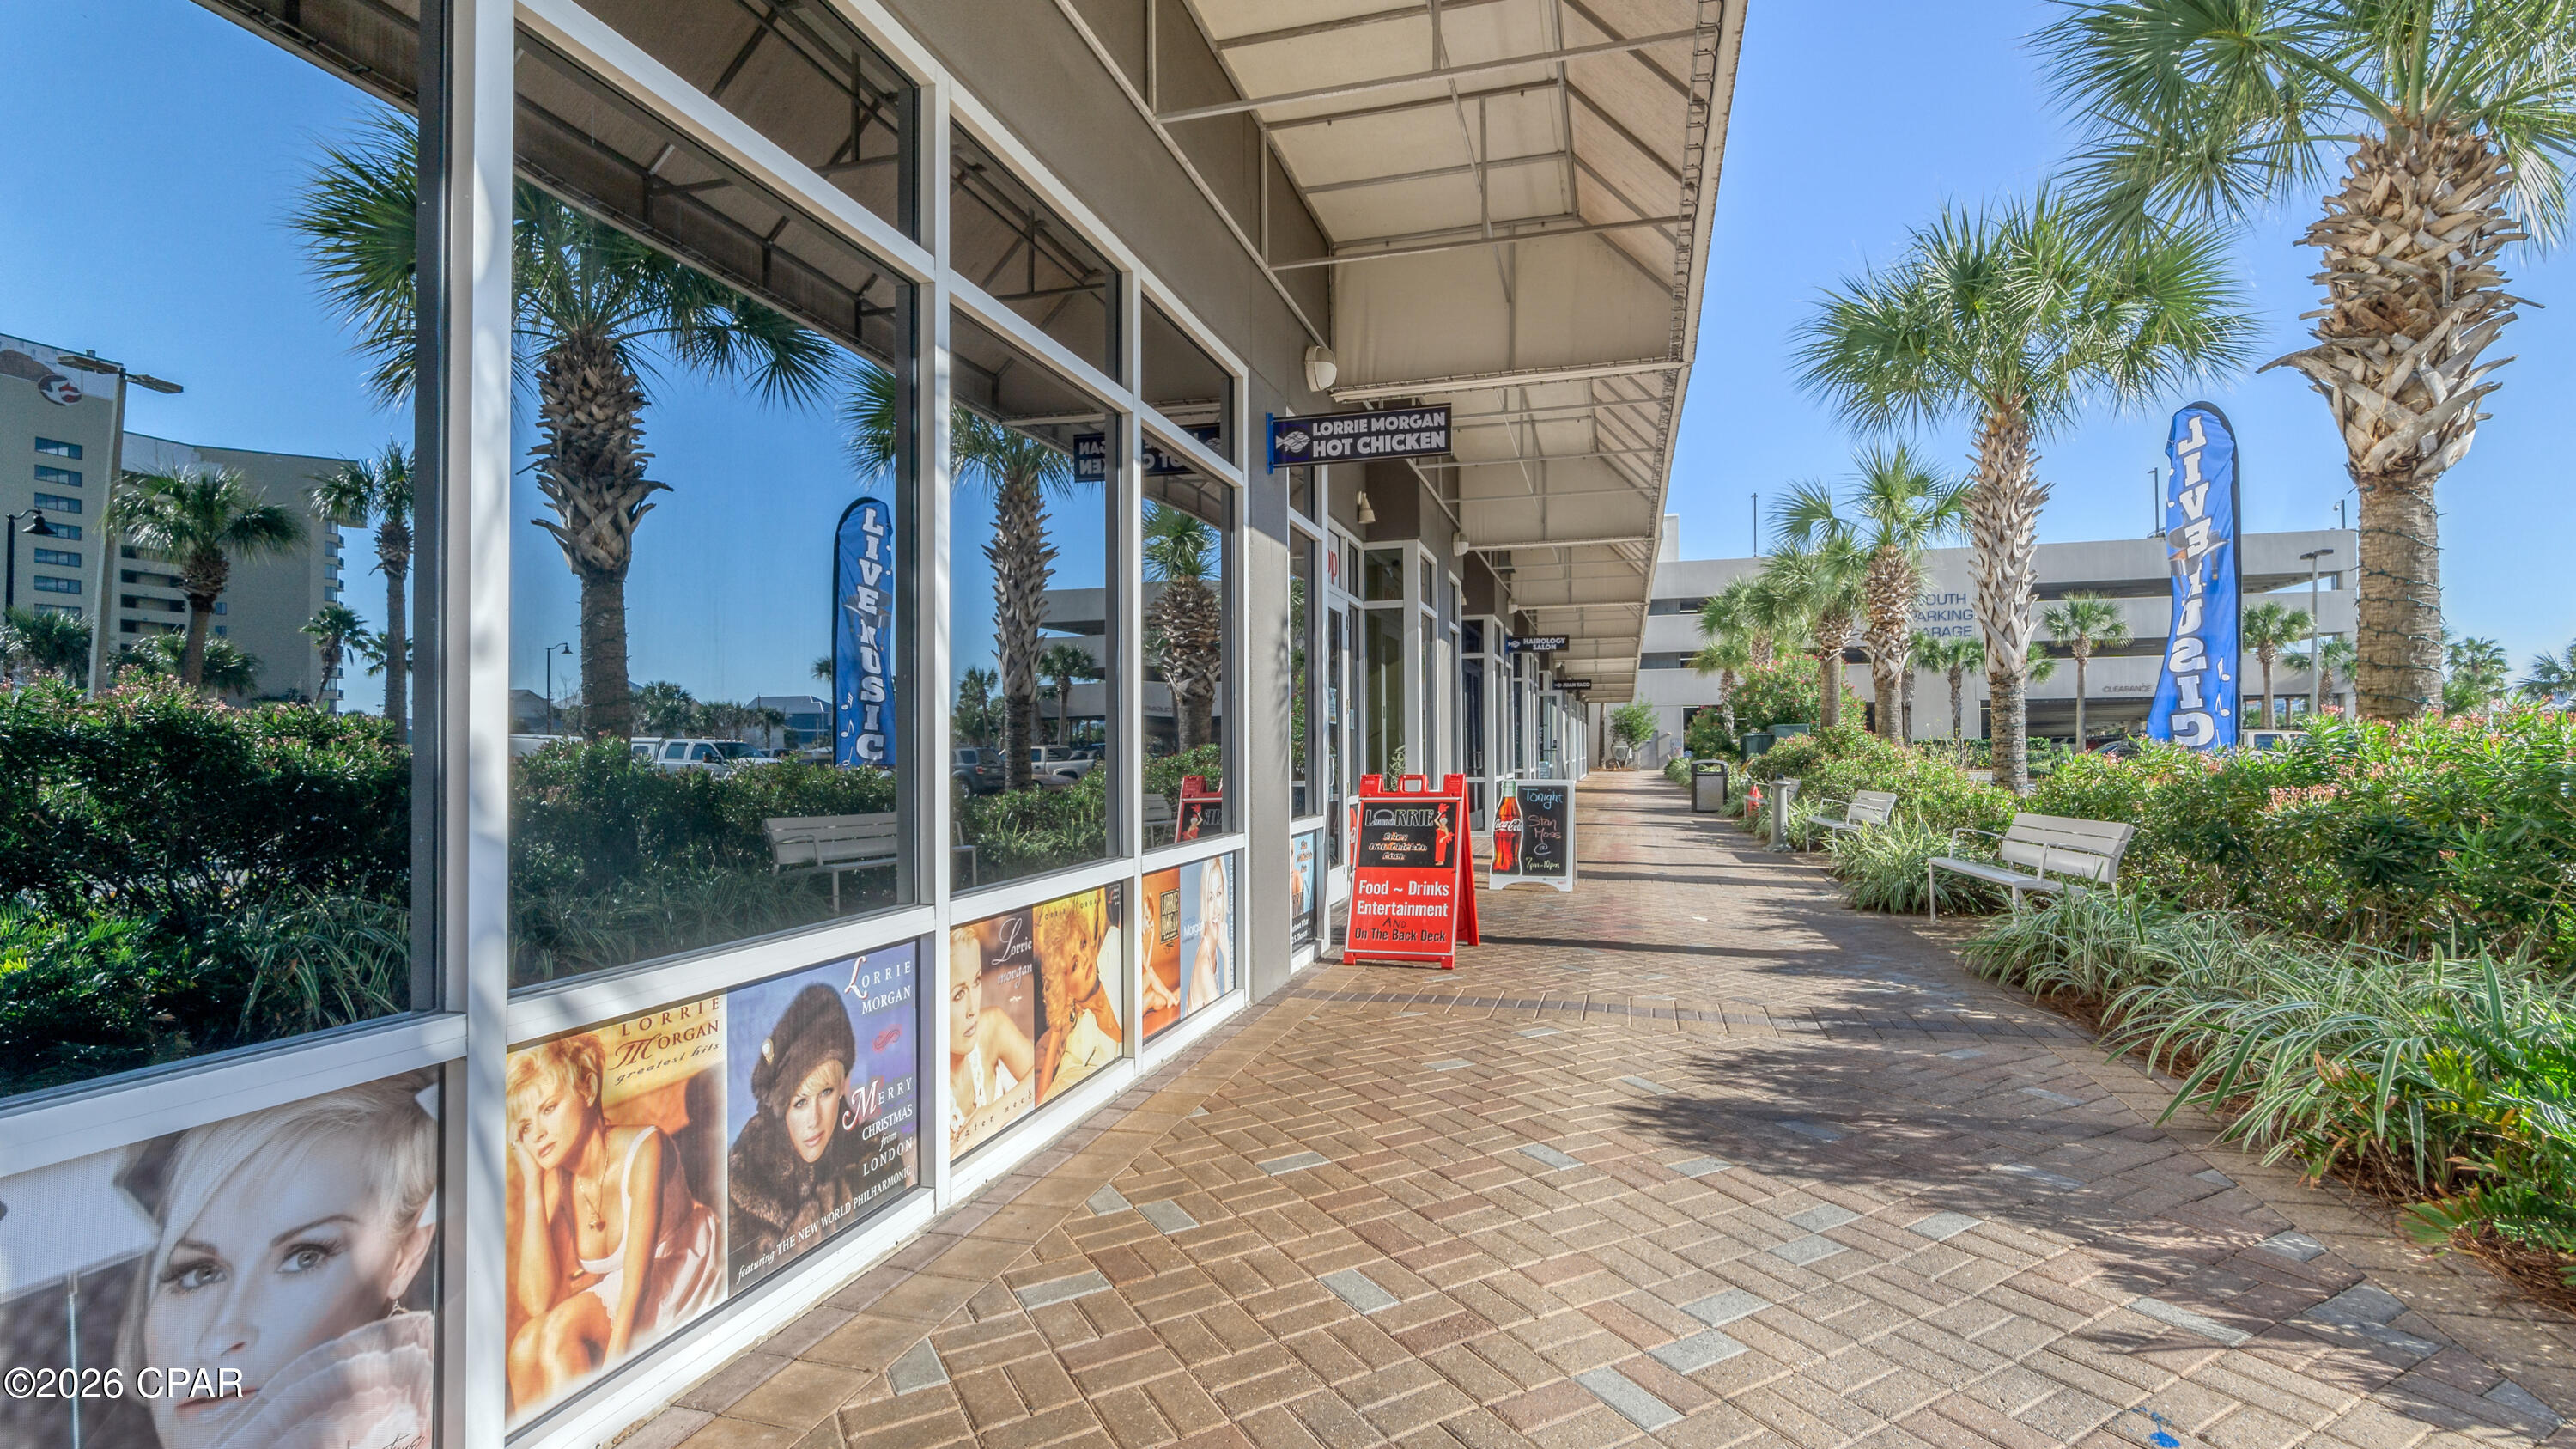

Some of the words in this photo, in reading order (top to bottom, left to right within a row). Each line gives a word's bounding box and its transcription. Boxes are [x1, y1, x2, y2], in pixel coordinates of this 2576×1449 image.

[1313, 418, 1367, 436] LORRIE
[1371, 412, 1445, 432] MORGAN
[1313, 438, 1353, 458] HOT
[1357, 430, 1446, 454] CHICKEN
[857, 508, 884, 615] LIVE
[1523, 636, 1565, 645] HAIROLOGY
[1911, 625, 1972, 637] ARAGE
[2102, 685, 2151, 693] CLEARANCE
[1521, 788, 1564, 810] Tonight
[1365, 809, 1434, 826] LORRIE
[1528, 815, 1557, 831] Stan
[1534, 828, 1561, 843] Moss
[1358, 880, 1389, 895] Food
[1408, 880, 1449, 896] Drinks
[1357, 900, 1448, 917] Entertainment
[1355, 928, 1368, 940] On
[1371, 928, 1388, 941] The
[1392, 928, 1418, 941] Back
[1420, 929, 1446, 942] Deck
[1382, 917, 1406, 928] AND
[991, 917, 1032, 965] Lorrie
[844, 956, 911, 1000] LORRIE
[997, 963, 1032, 989] morgan
[861, 985, 911, 1014] MORGAN
[622, 997, 719, 1037] LORRIE
[608, 1020, 719, 1071] MORGAN
[615, 1052, 686, 1086] greatest
[690, 1043, 719, 1057] hits
[842, 1077, 912, 1130] MERRY
[862, 1104, 913, 1141] CHRISTMAS
[879, 1131, 897, 1152] from
[862, 1136, 913, 1177] LONDON
[736, 1250, 775, 1285] featuring
[776, 1233, 797, 1256] THE
[797, 1221, 820, 1243] NEW
[820, 1202, 851, 1230] WORLD
[853, 1165, 912, 1209] PHILHARMONIC
